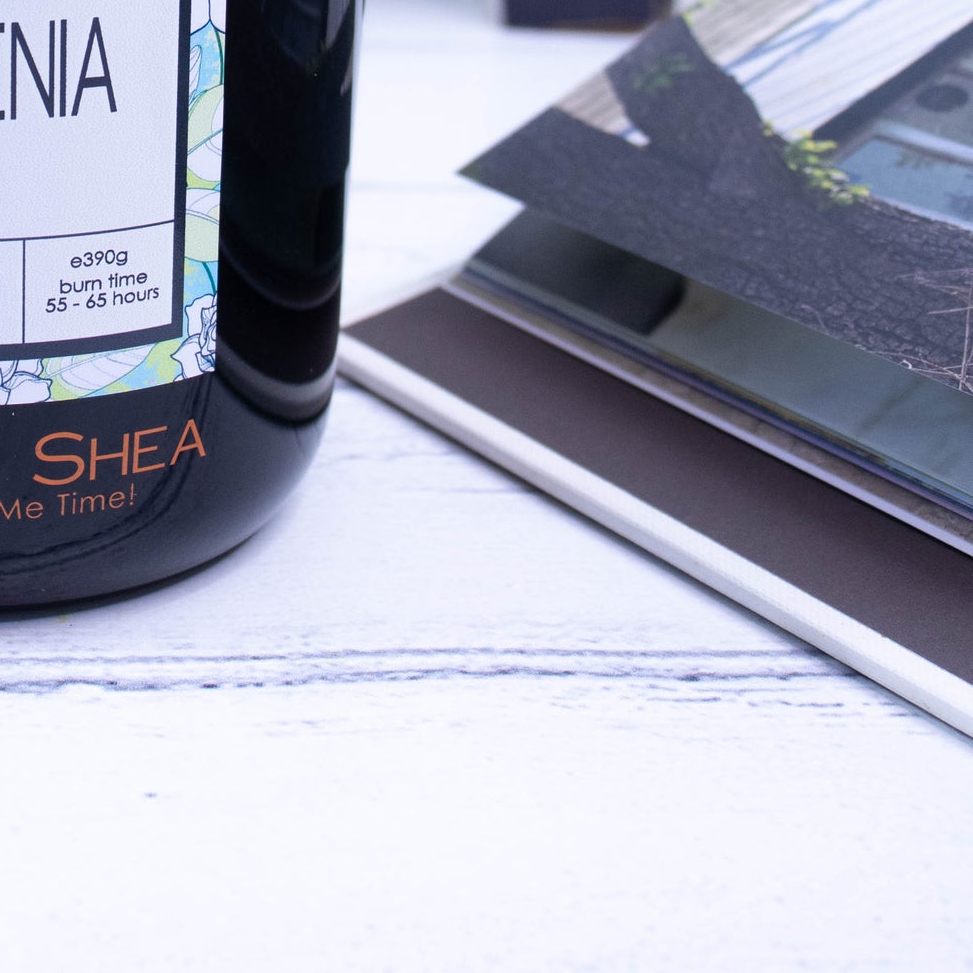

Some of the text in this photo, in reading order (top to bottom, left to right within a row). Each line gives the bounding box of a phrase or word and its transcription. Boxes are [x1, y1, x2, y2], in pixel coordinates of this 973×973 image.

[70, 249, 128, 269] e390g
[59, 272, 148, 295] burn time
[45, 297, 68, 313] 55
[85, 292, 107, 309] 65
[112, 287, 160, 306] hours
[32, 418, 207, 487] SHEA
[56, 482, 139, 518] Time!
